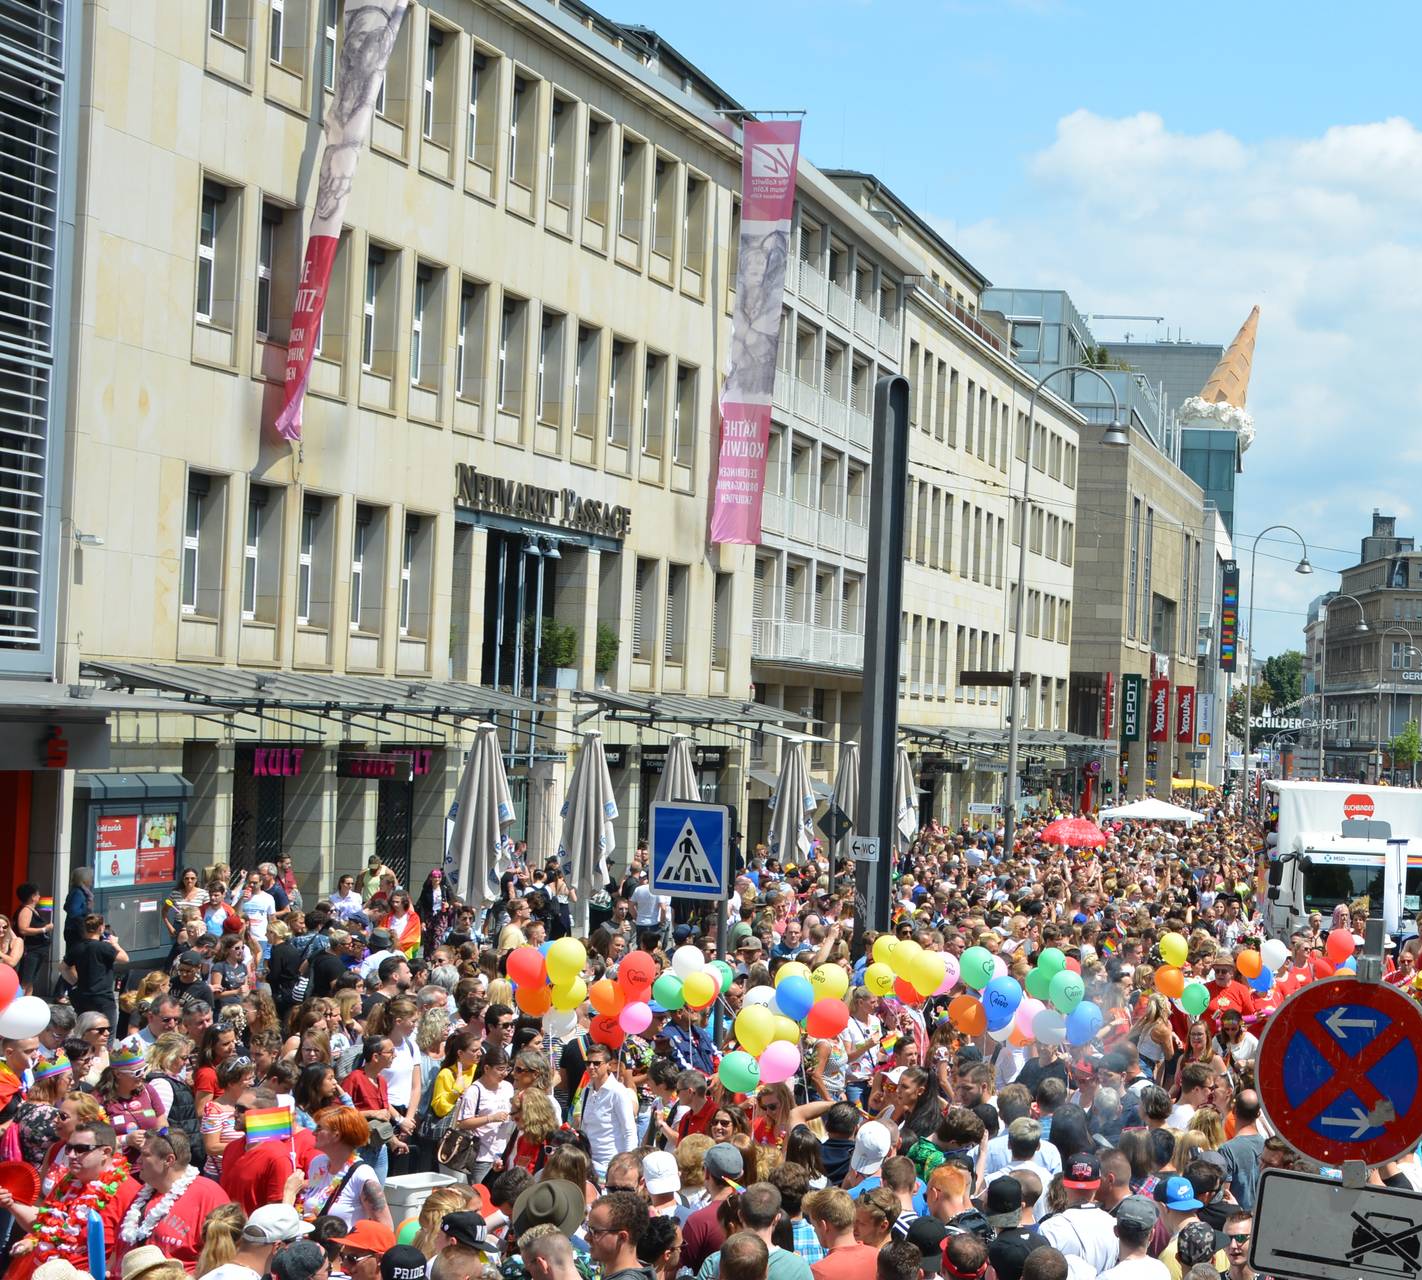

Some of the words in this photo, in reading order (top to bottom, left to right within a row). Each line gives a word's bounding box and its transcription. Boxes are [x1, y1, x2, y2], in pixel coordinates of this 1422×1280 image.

[1126, 680, 1138, 735] DEPOT
[1249, 716, 1338, 730] SCHILDERGASSE
[254, 749, 304, 776] KULT
[862, 843, 875, 855] WC
[993, 998, 1009, 1009] AWO
[393, 1264, 425, 1280] PRIDE
